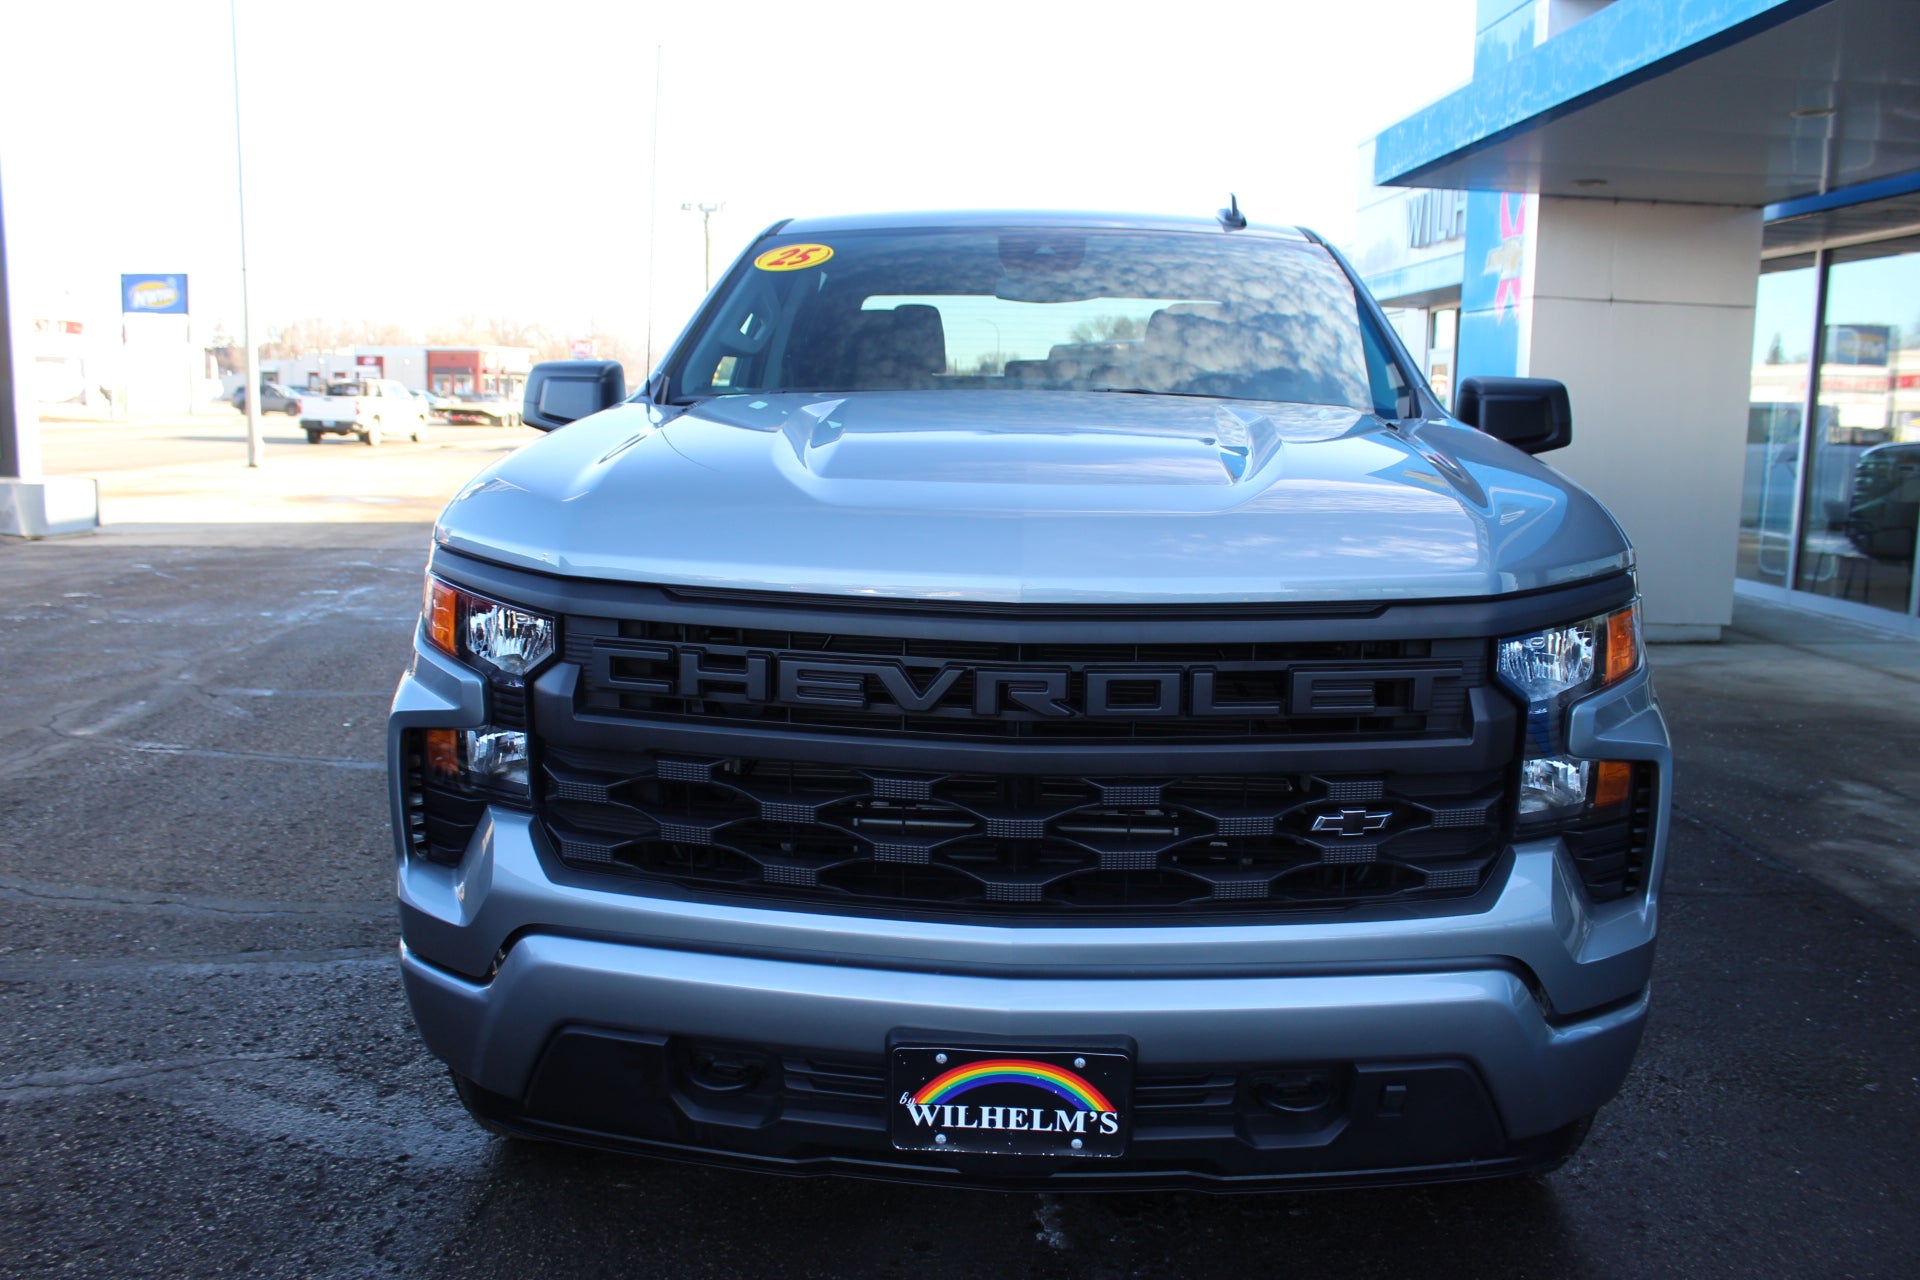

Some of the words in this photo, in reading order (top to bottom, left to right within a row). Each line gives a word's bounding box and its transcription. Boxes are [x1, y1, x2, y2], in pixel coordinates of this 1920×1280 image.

[767, 248, 821, 266] 25
[594, 640, 1463, 716] CHEVROLET
[900, 1092, 918, 1108] by
[907, 1104, 1119, 1134] WILHELM'S
